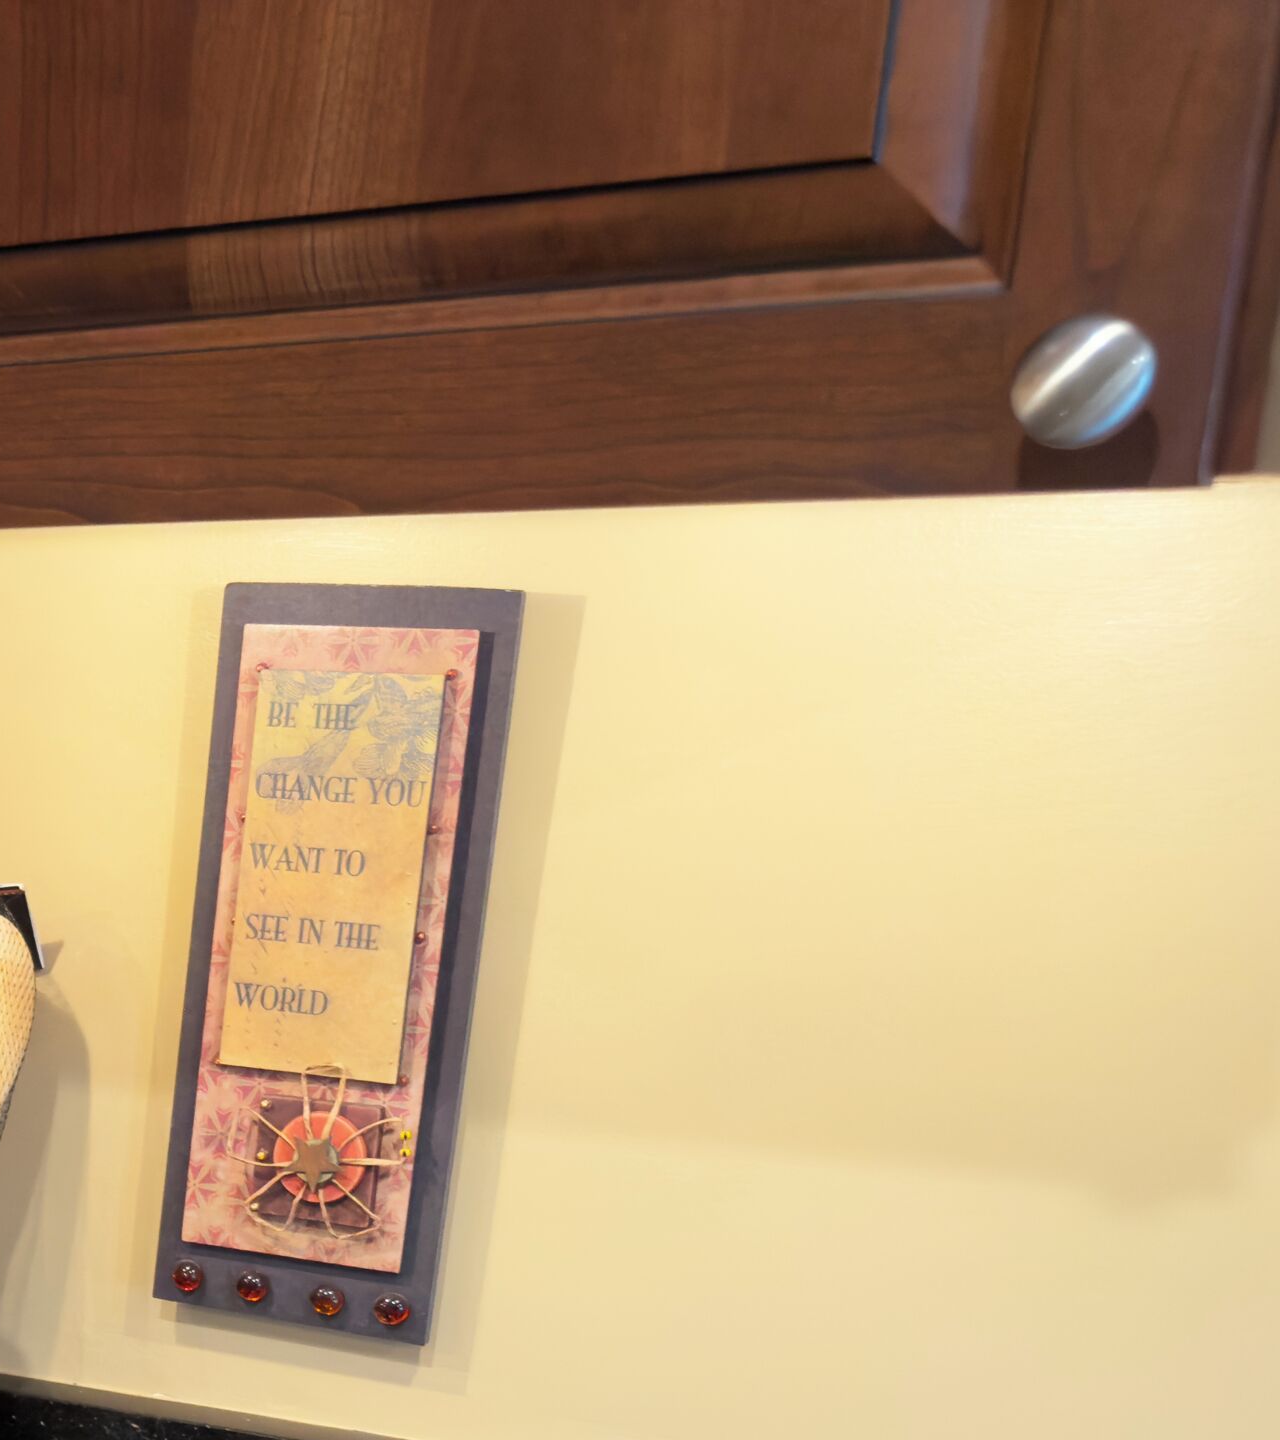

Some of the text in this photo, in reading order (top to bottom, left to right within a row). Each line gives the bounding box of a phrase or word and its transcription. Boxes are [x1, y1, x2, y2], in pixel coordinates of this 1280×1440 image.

[266, 701, 358, 731] BE THE
[254, 771, 427, 808] CHANGE YOU
[250, 843, 366, 877] WANT TO
[245, 913, 381, 952] SEE IN THE
[234, 981, 329, 1015] WORLD
